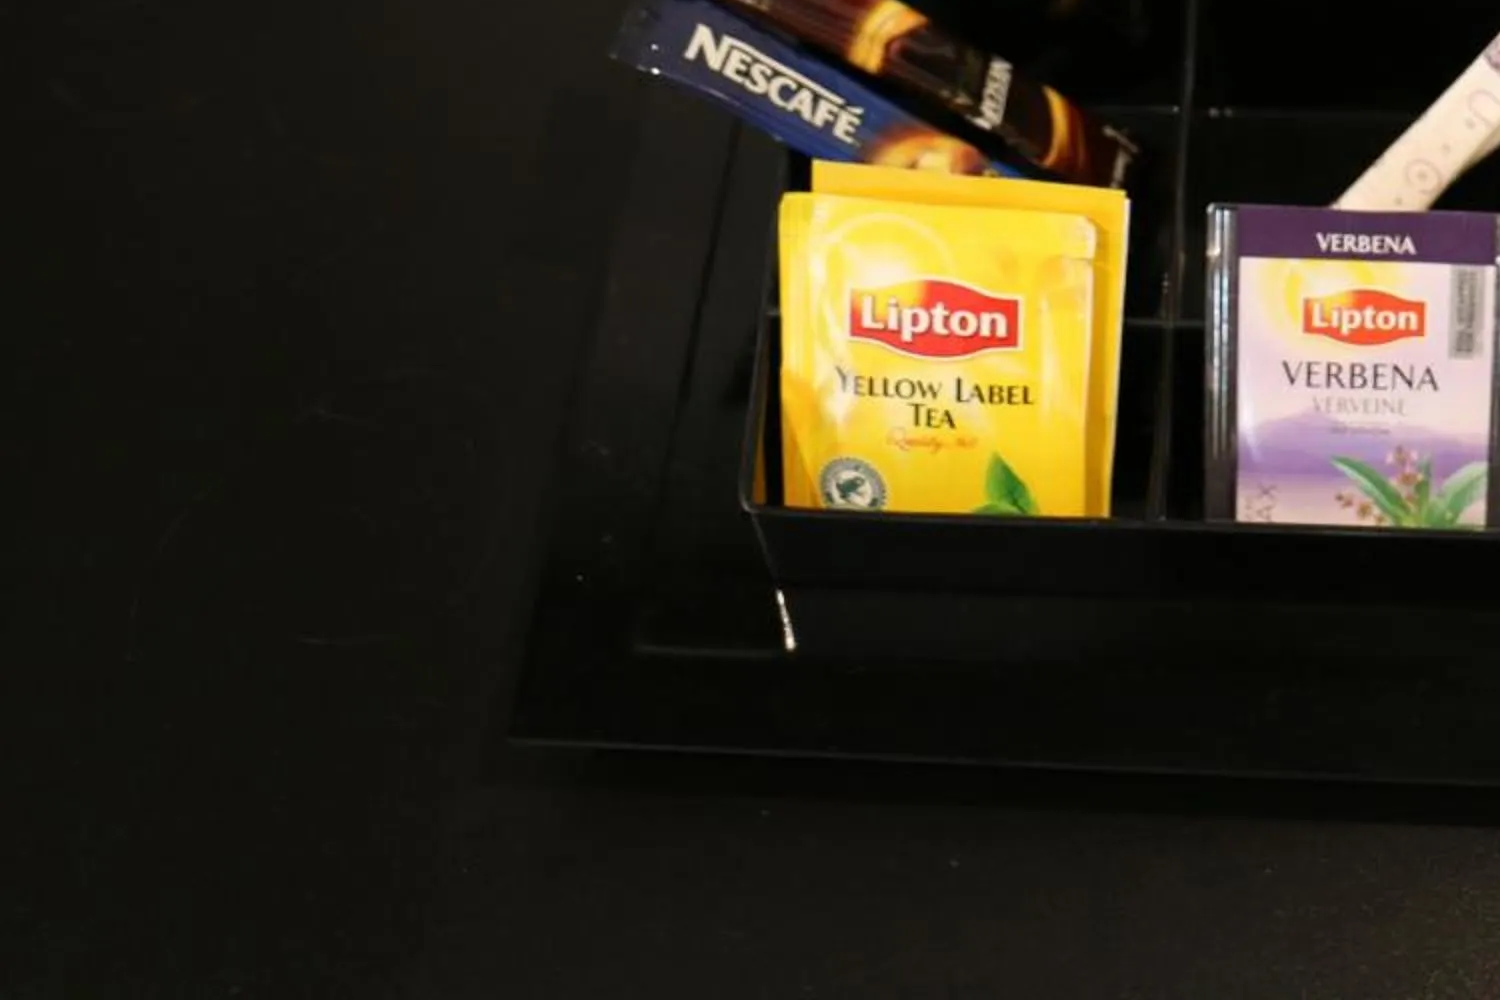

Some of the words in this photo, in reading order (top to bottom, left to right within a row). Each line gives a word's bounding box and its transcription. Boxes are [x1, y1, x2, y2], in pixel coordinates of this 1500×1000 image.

[684, 23, 864, 146] NESCAFÉ
[1315, 232, 1417, 255] VERBENA
[860, 295, 1008, 342] Lipton
[1311, 303, 1418, 335] Lipton
[835, 365, 943, 400] YELLOW
[954, 376, 1034, 405] LABEL
[1282, 359, 1440, 393] VERBENA
[907, 402, 957, 429] TEA
